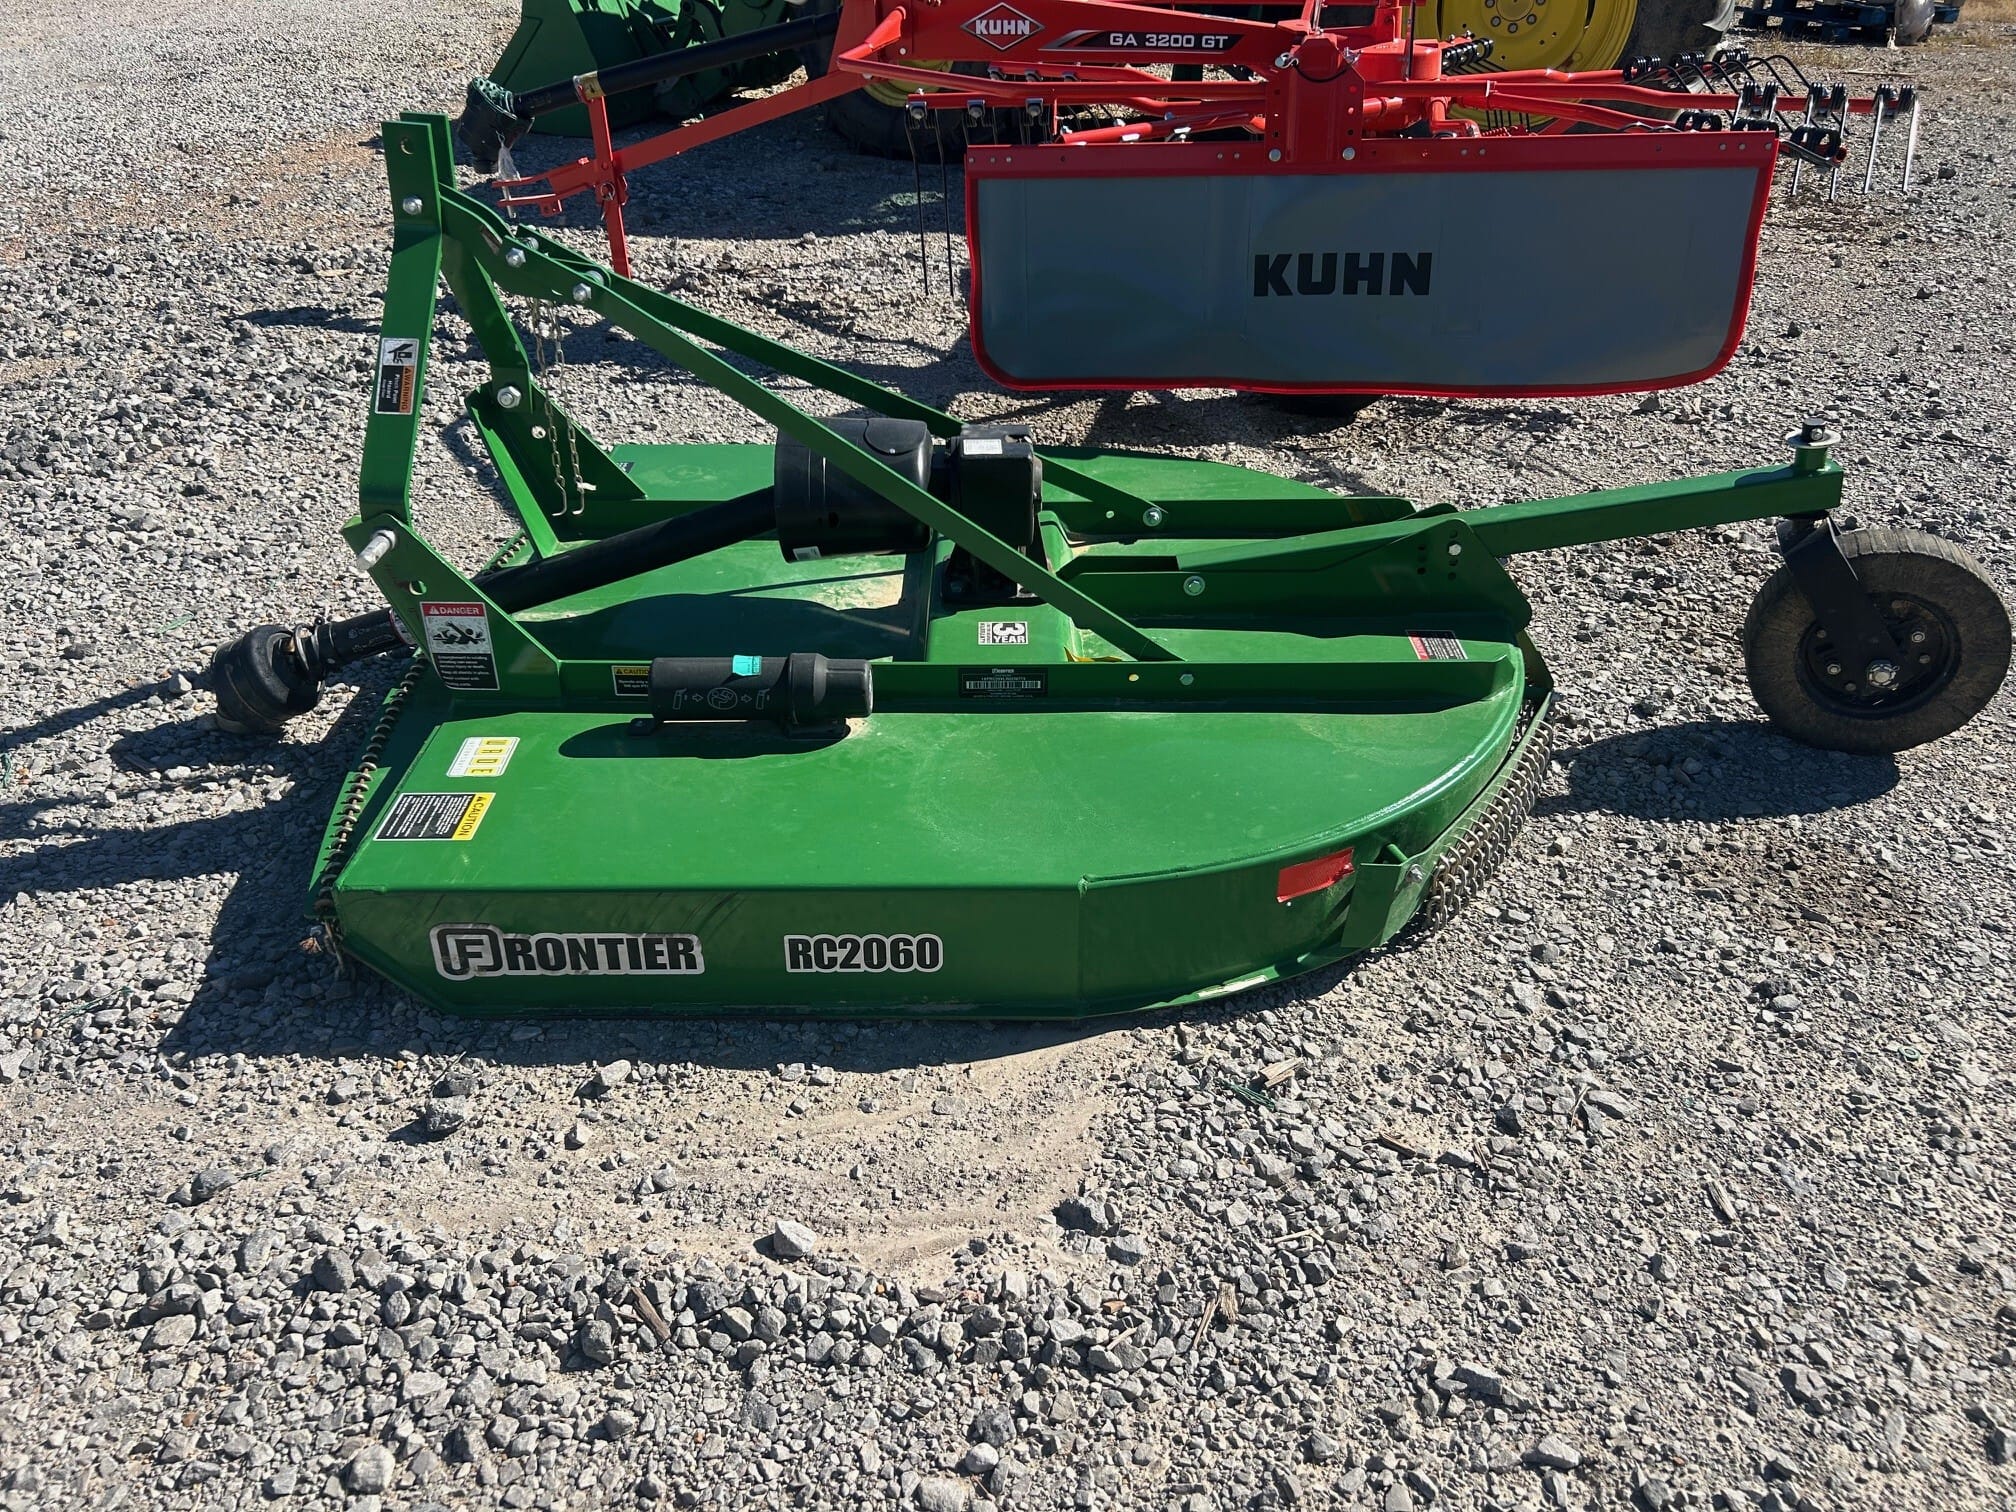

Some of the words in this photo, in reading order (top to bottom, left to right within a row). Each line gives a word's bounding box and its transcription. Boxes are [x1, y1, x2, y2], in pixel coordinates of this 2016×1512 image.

[975, 20, 1031, 35] KUHN
[1109, 33, 1138, 46] GA
[1145, 34, 1195, 48] 3200
[1201, 35, 1229, 49] GT
[1253, 252, 1433, 297] KUHN
[402, 374, 411, 410] WARNING
[440, 607, 480, 615] DANGER
[993, 623, 1025, 636] 3
[458, 802, 484, 836] CAUTION
[437, 927, 699, 976] FRONTIER
[788, 936, 931, 970] RC2060
